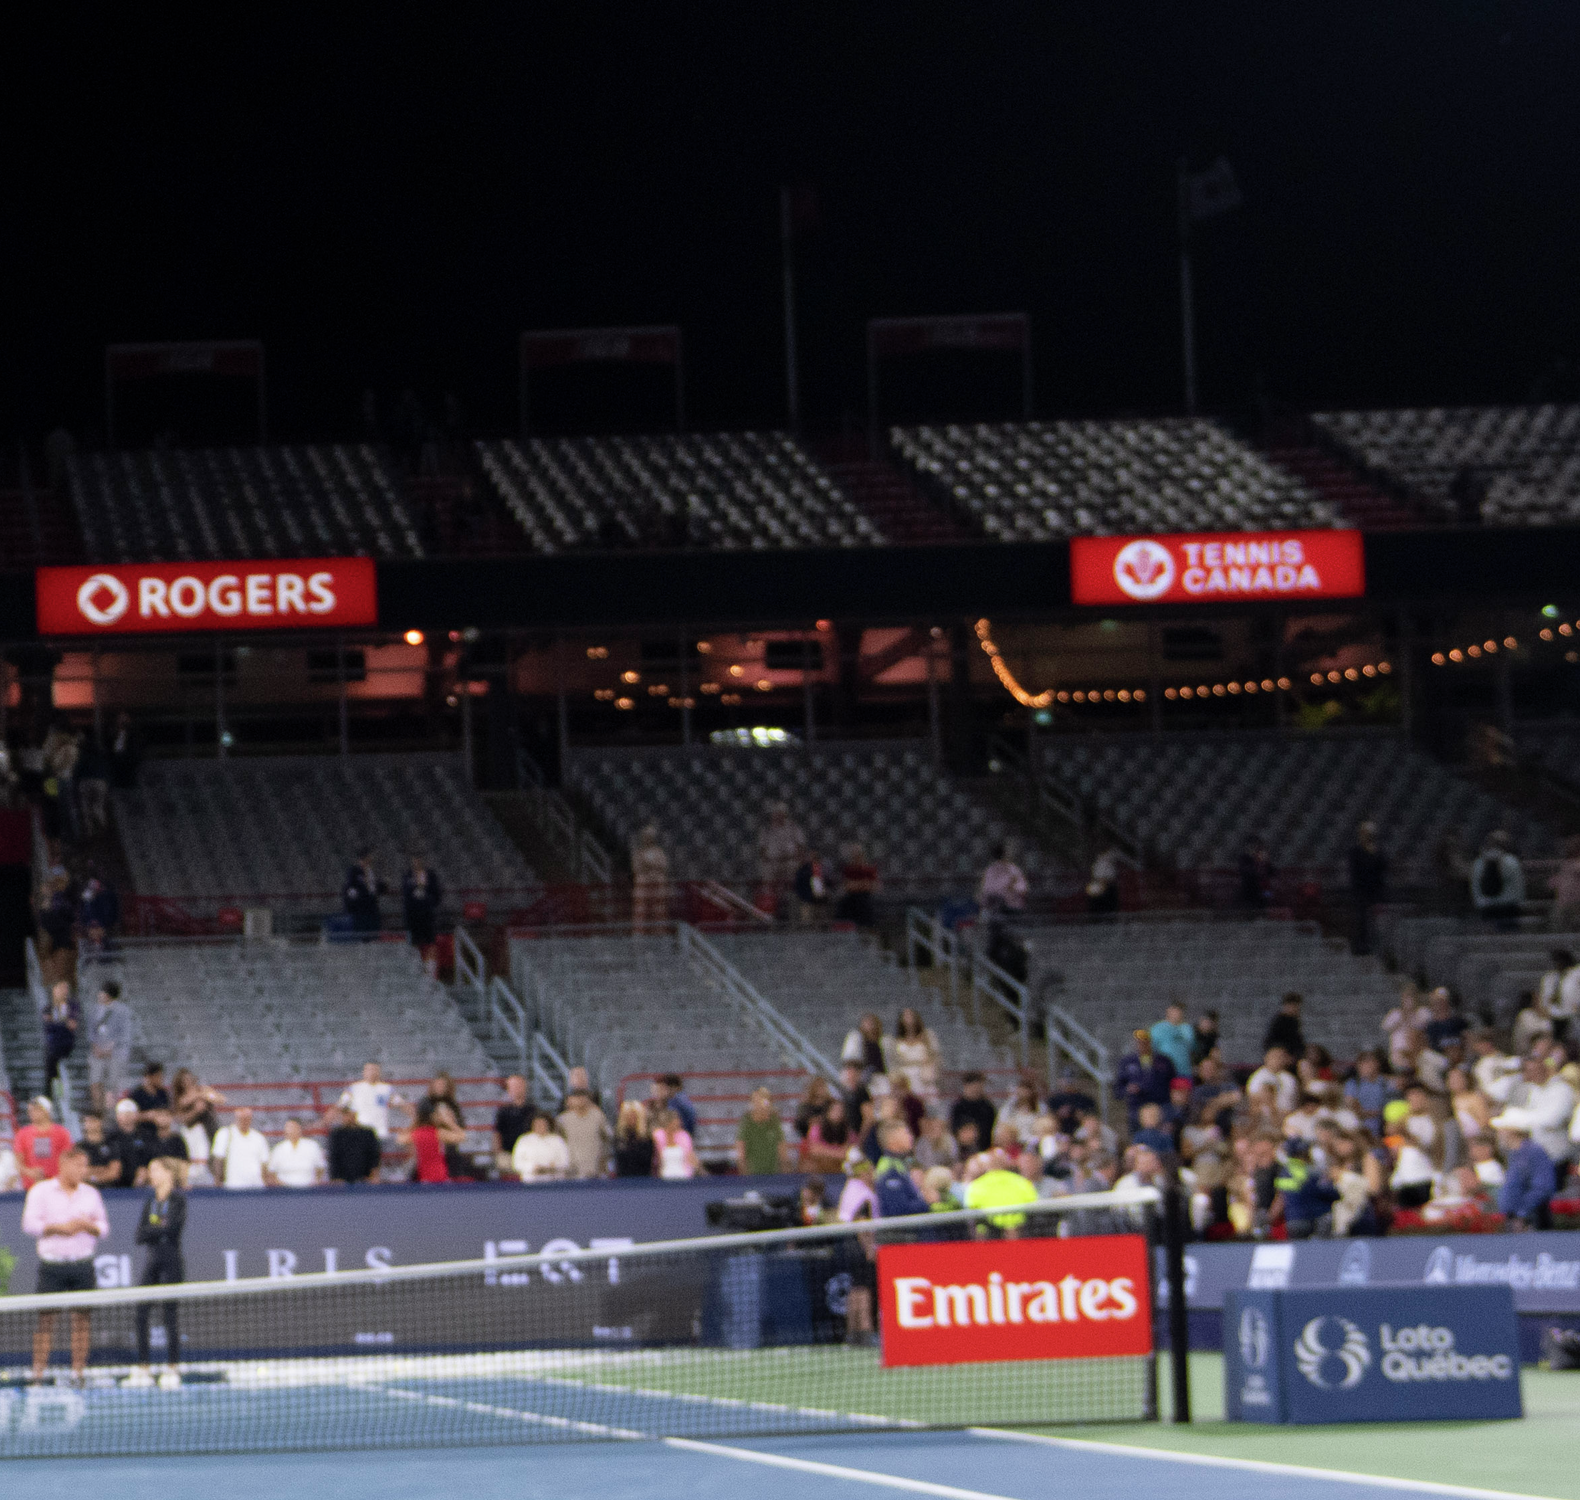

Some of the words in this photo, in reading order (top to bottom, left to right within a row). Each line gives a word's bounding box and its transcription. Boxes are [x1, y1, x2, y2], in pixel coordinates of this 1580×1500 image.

[1182, 539, 1305, 567] TENNIS
[138, 571, 336, 617] ROGERS
[1182, 566, 1320, 594] CANADA
[97, 1254, 132, 1287] GI
[221, 1245, 394, 1284] IRIS
[894, 1272, 1138, 1329] Emirates
[1379, 1324, 1455, 1352] Loto
[1380, 1350, 1512, 1383] Québec
